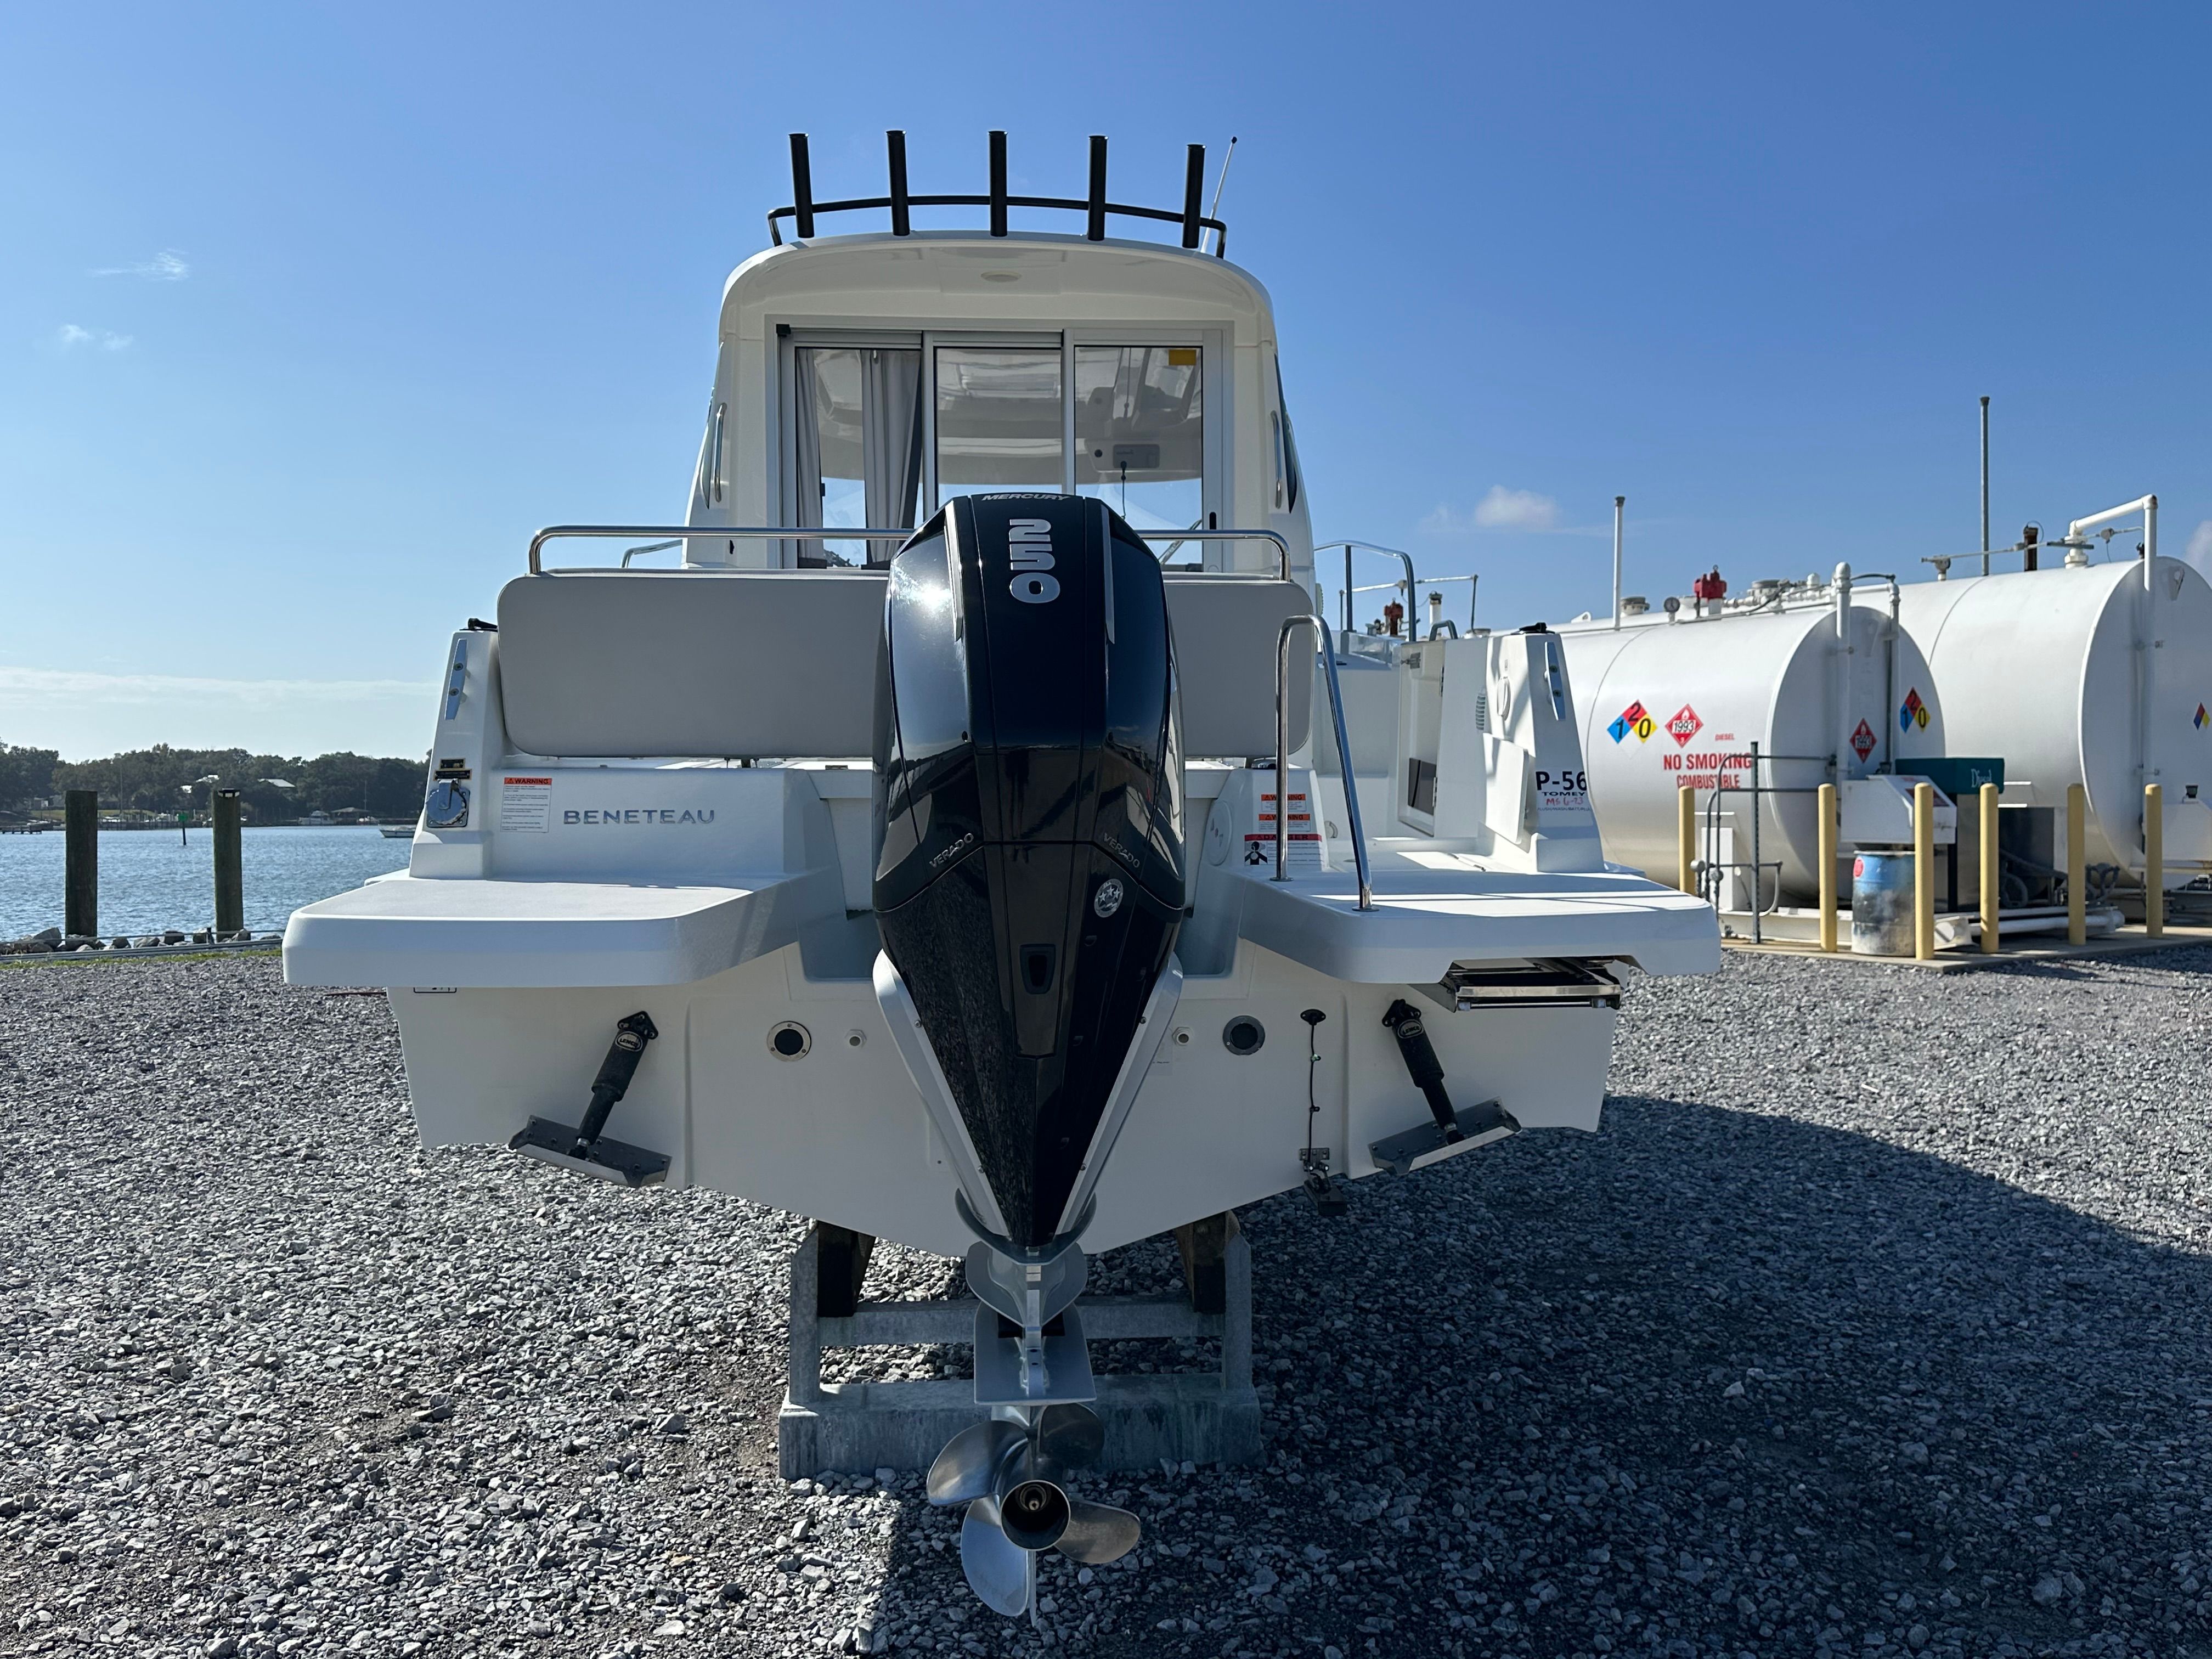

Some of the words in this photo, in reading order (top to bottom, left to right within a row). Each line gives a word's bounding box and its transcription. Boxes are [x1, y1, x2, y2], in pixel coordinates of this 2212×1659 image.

[1009, 518, 1060, 603] 250
[1628, 702, 1641, 722] 2
[1918, 706, 1927, 728] 0
[1616, 719, 1624, 739] 1
[1639, 718, 1651, 738] 0
[1674, 720, 1694, 732] 1993
[1663, 754, 1682, 770] NO
[1686, 752, 1753, 770] SMOKING
[1536, 771, 1587, 791] P-56
[563, 810, 715, 825] BENETEAU
[929, 832, 974, 868] VERADO
[1104, 832, 1140, 868] VERADO
